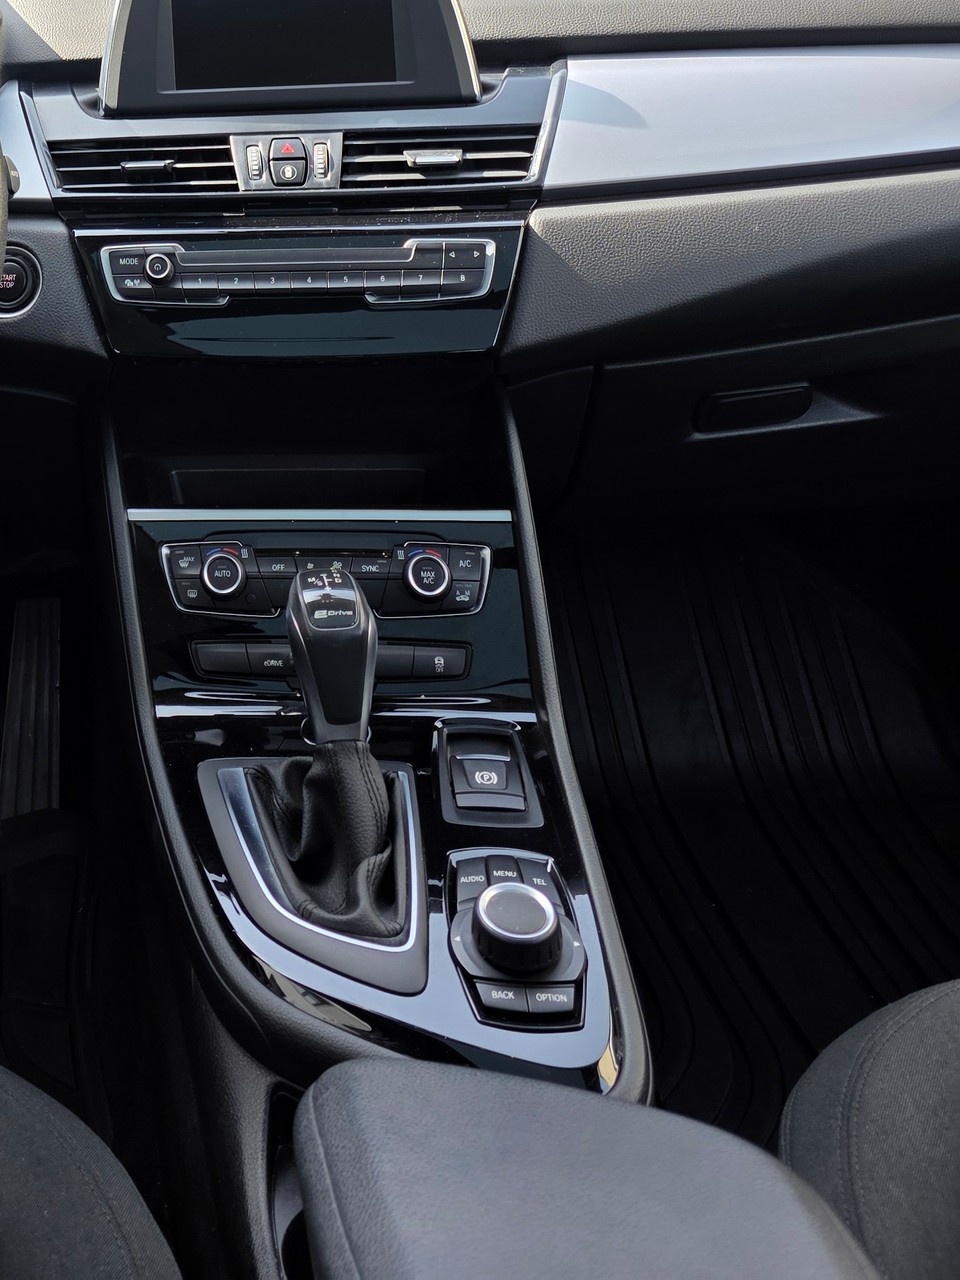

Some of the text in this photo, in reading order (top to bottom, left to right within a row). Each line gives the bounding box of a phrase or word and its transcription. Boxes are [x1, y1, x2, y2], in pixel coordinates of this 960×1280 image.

[0, 281, 15, 289] STOP
[459, 560, 472, 568] A/C
[314, 609, 354, 619] eDrive
[263, 659, 284, 667] eDRIVE
[493, 870, 517, 878] MENU
[460, 875, 485, 883] AUDIO
[532, 877, 547, 886] TEL
[491, 990, 515, 1000] BACK
[535, 993, 568, 1002] OPTION
